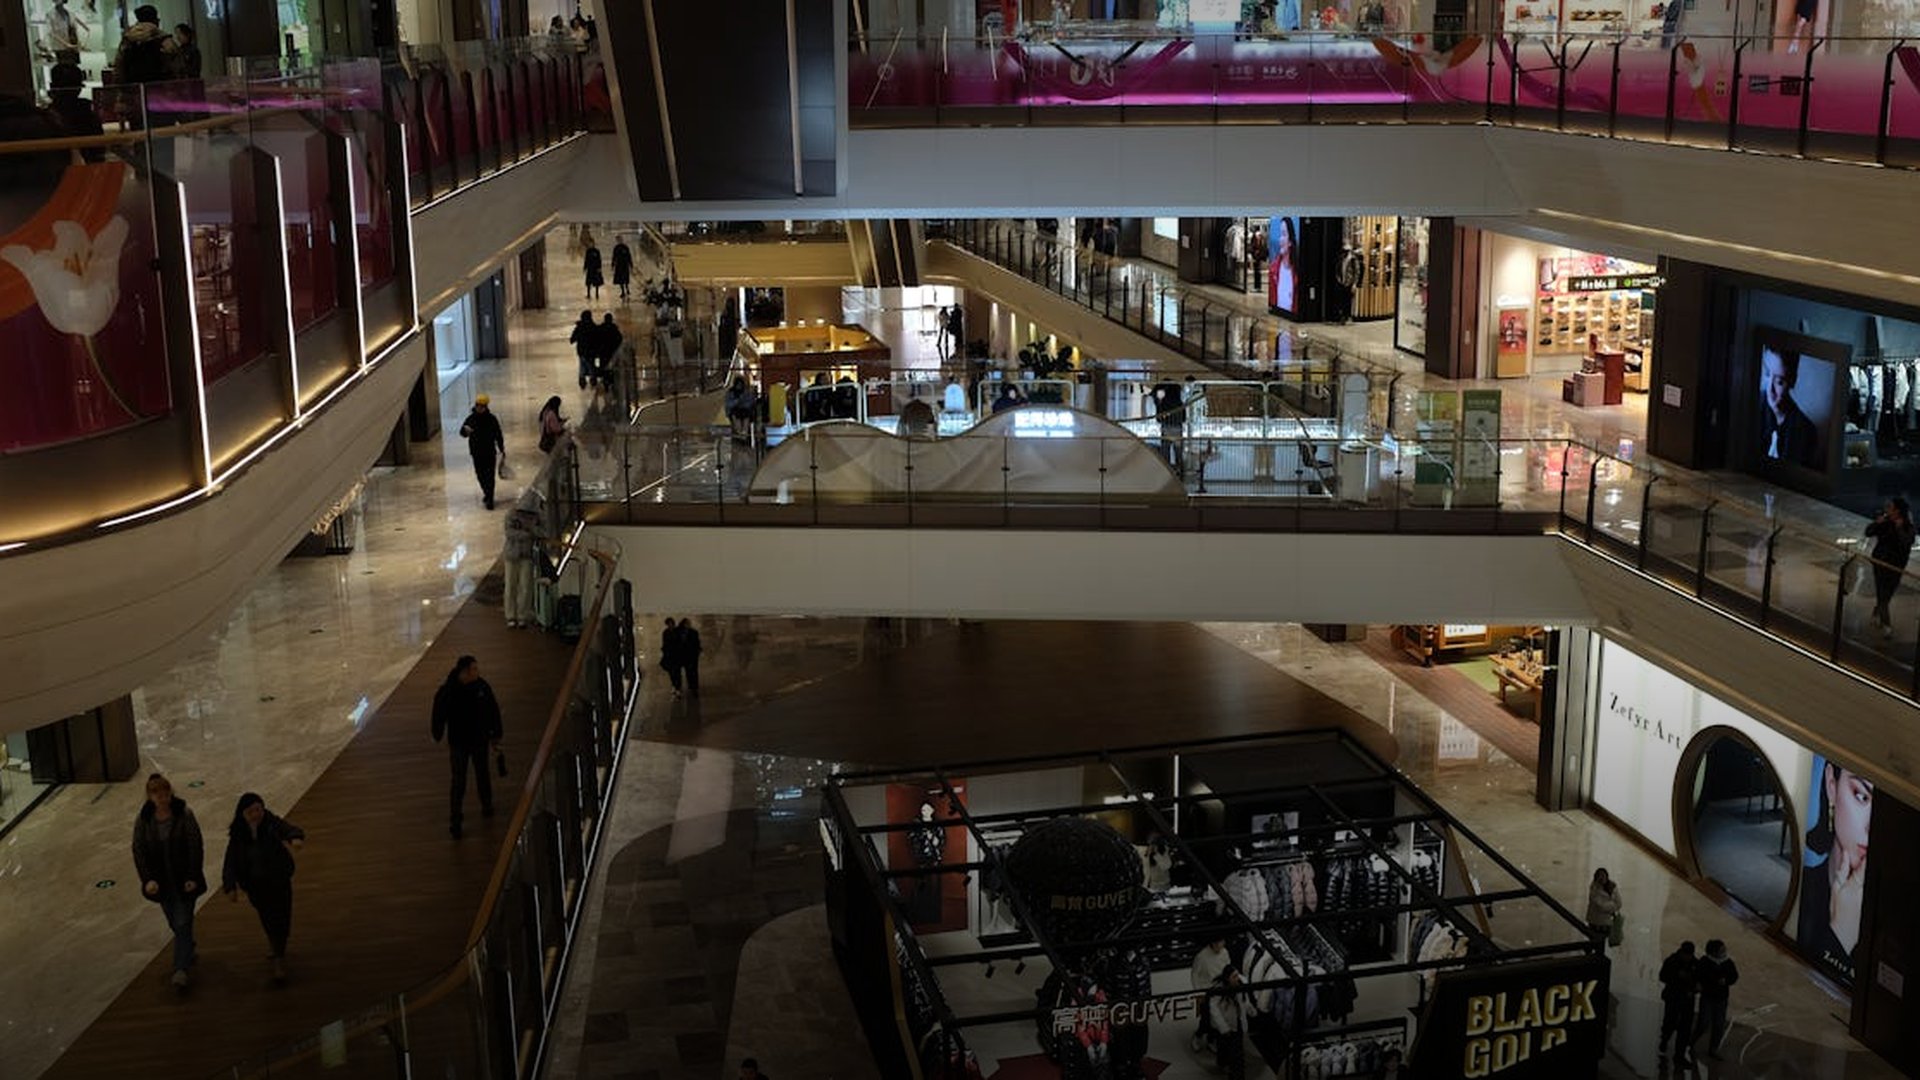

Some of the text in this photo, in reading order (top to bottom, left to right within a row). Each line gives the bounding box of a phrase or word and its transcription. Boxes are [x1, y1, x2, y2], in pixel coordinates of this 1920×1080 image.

[1610, 692, 1680, 749] Zefyr Art
[1466, 979, 1599, 1036] BLACK
